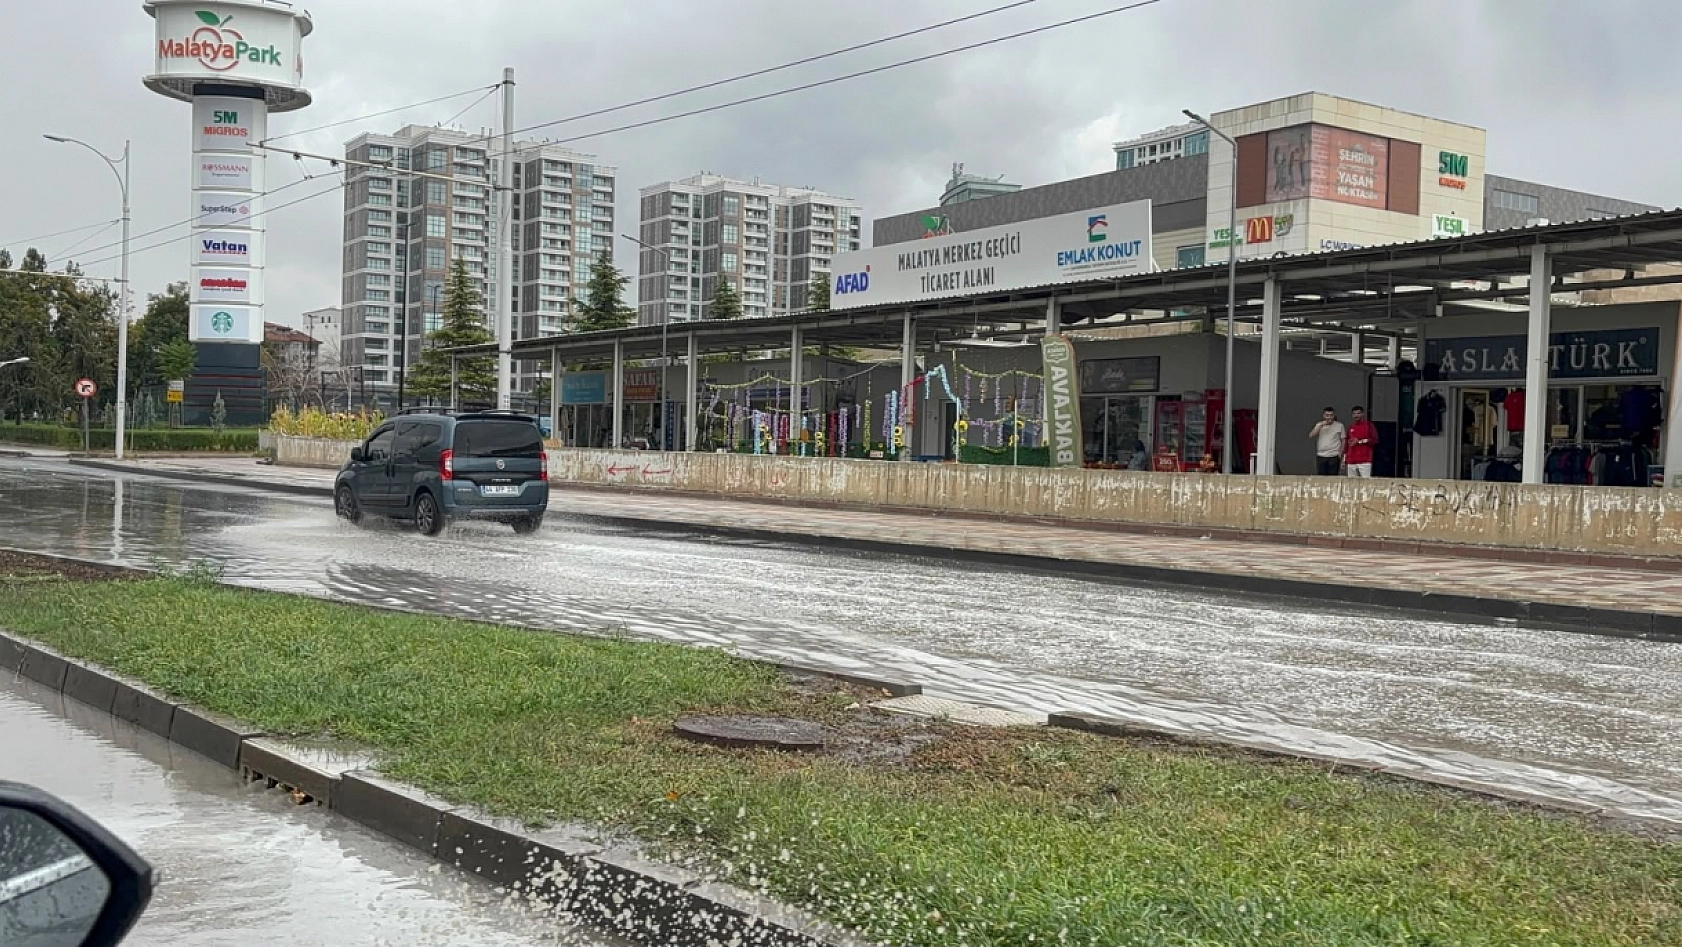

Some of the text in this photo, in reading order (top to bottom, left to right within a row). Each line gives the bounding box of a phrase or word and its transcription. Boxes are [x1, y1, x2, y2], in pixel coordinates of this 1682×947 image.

[159, 37, 281, 66] MalatyaPark
[202, 239, 248, 251] Vatan
[898, 231, 1021, 271] MALATYA MERKEZ GEÇİCİ
[1057, 240, 1142, 266] EMLAK KONUT
[835, 271, 869, 295] AFAD
[921, 266, 995, 293] TİCARET ALANI
[1439, 337, 1639, 372] ASLATÜRK
